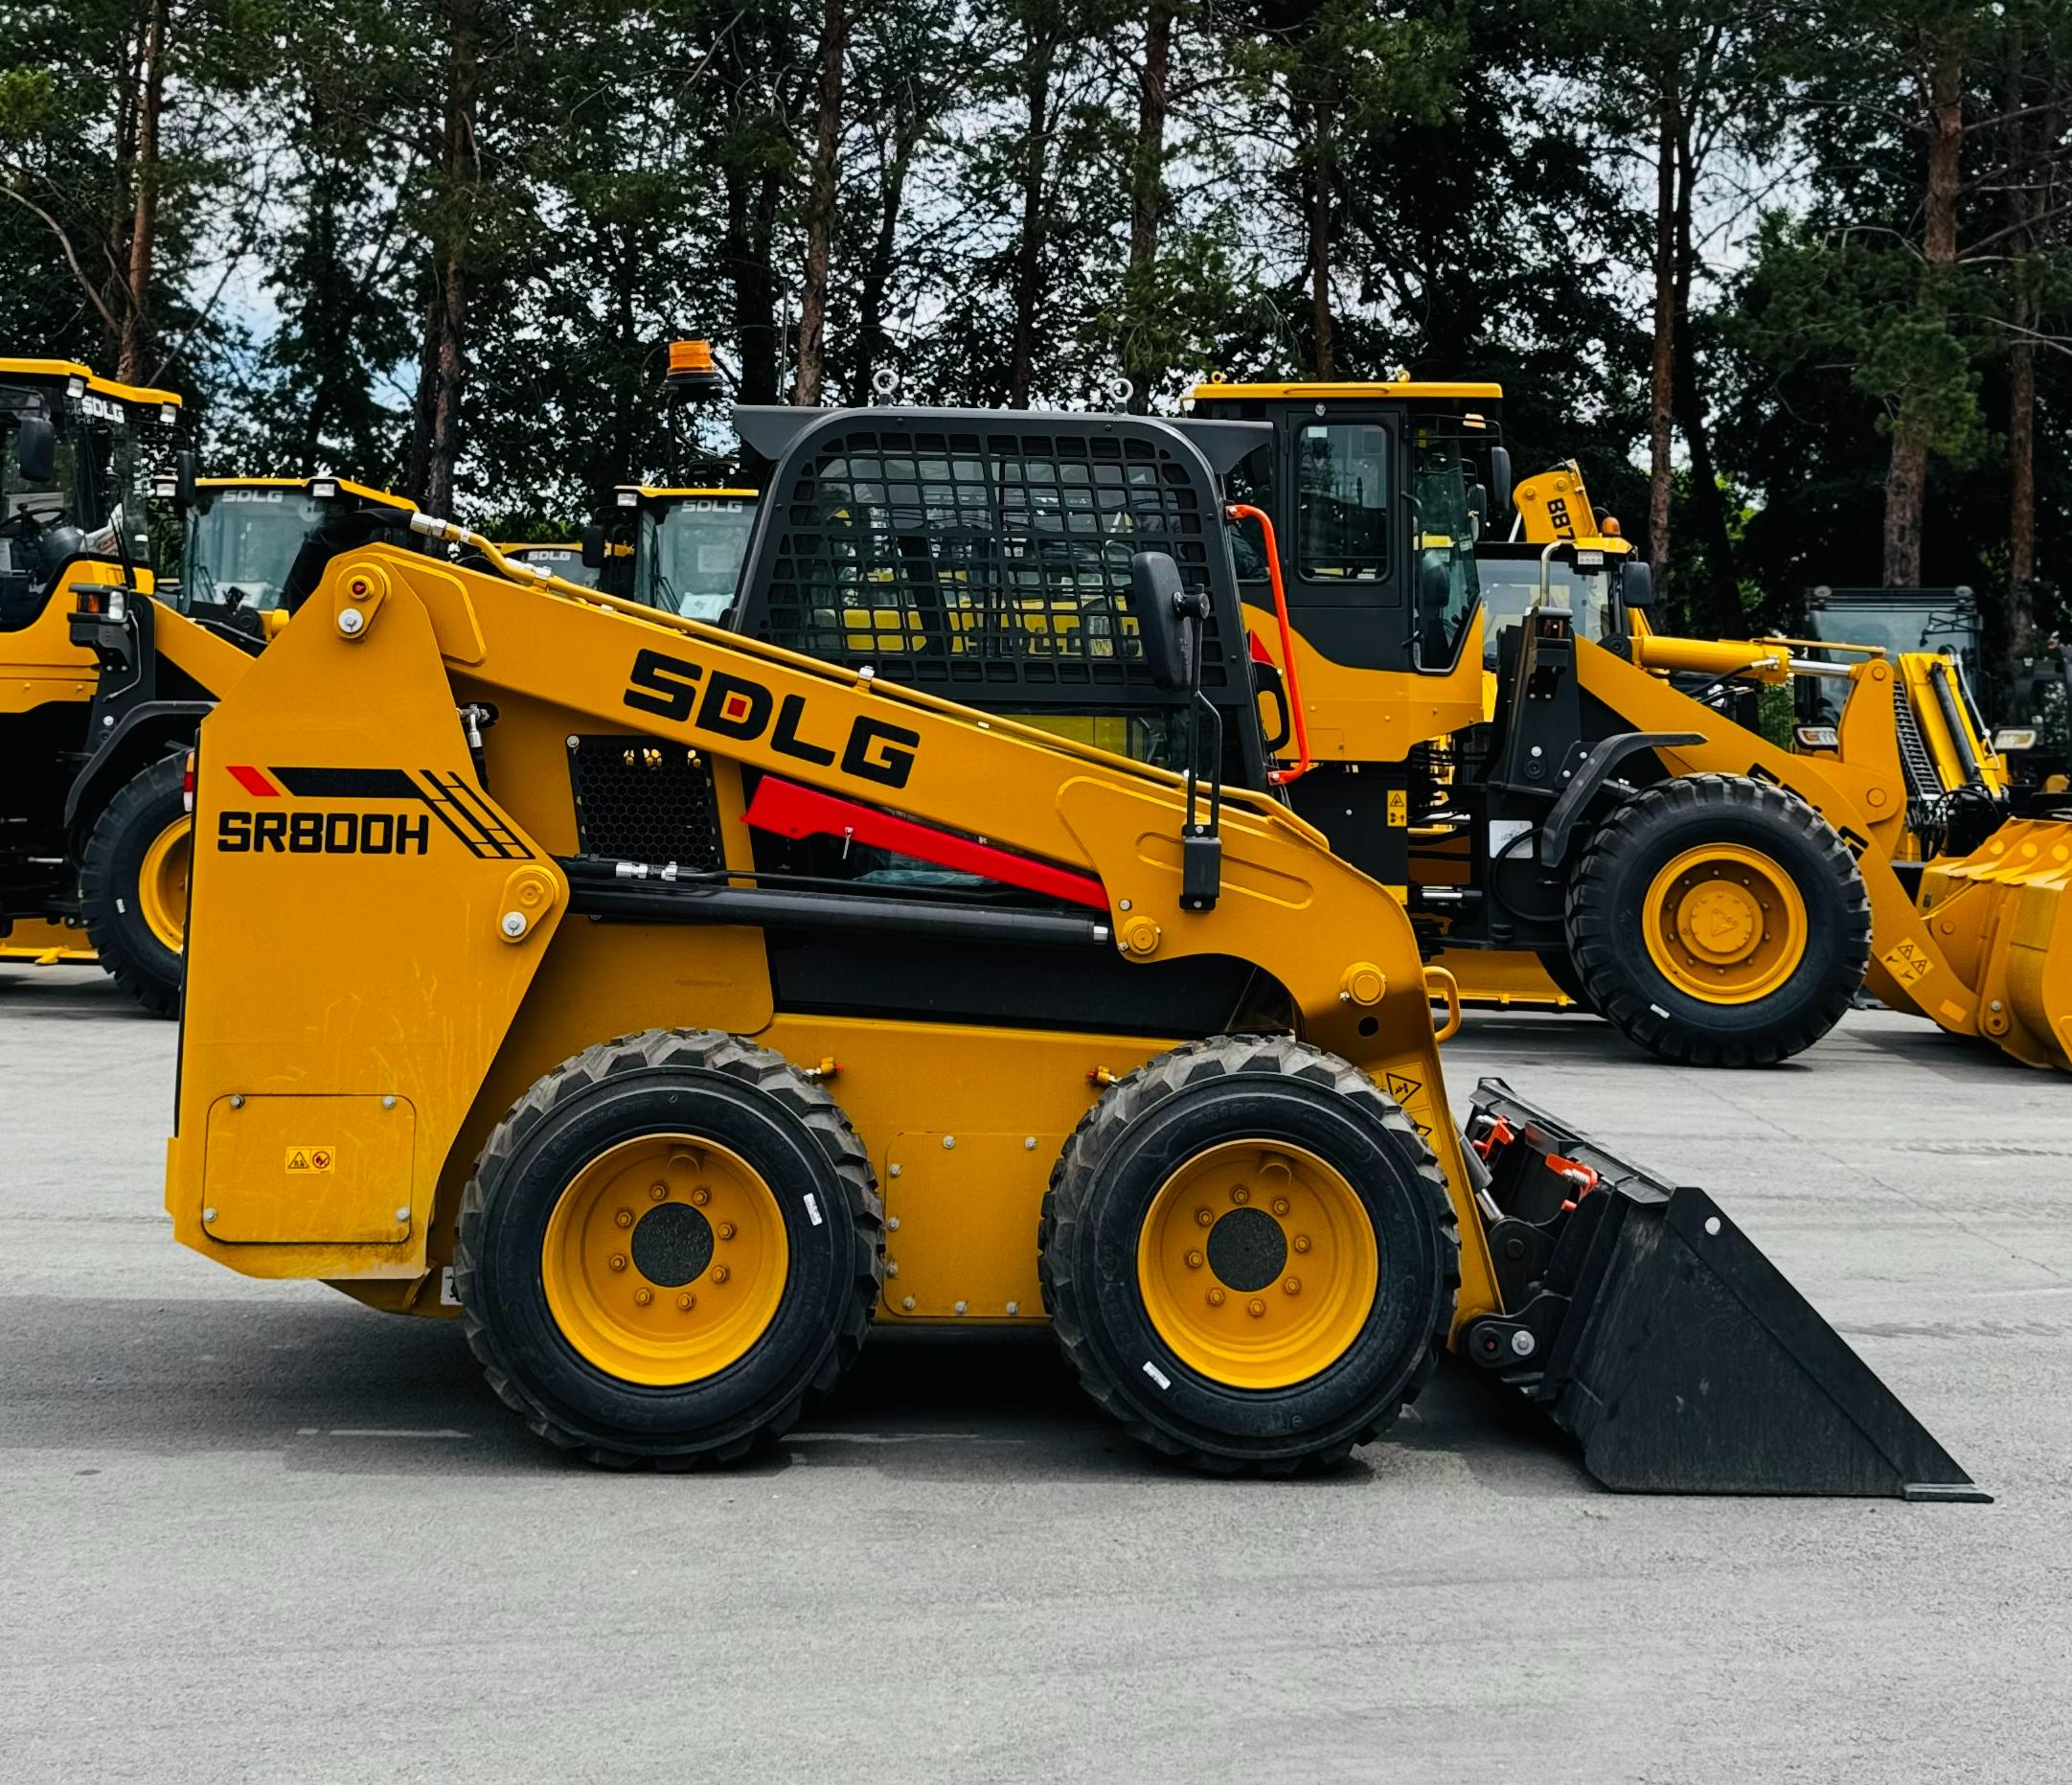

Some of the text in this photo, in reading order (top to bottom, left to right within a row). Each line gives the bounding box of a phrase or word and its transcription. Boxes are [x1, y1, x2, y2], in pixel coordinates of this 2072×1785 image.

[81, 395, 125, 423] SDLG
[221, 490, 284, 503] SDLG
[681, 499, 743, 513] SDLG
[527, 551, 572, 561] SDLG
[623, 648, 921, 790] SDLG
[217, 811, 429, 855] SR800H
